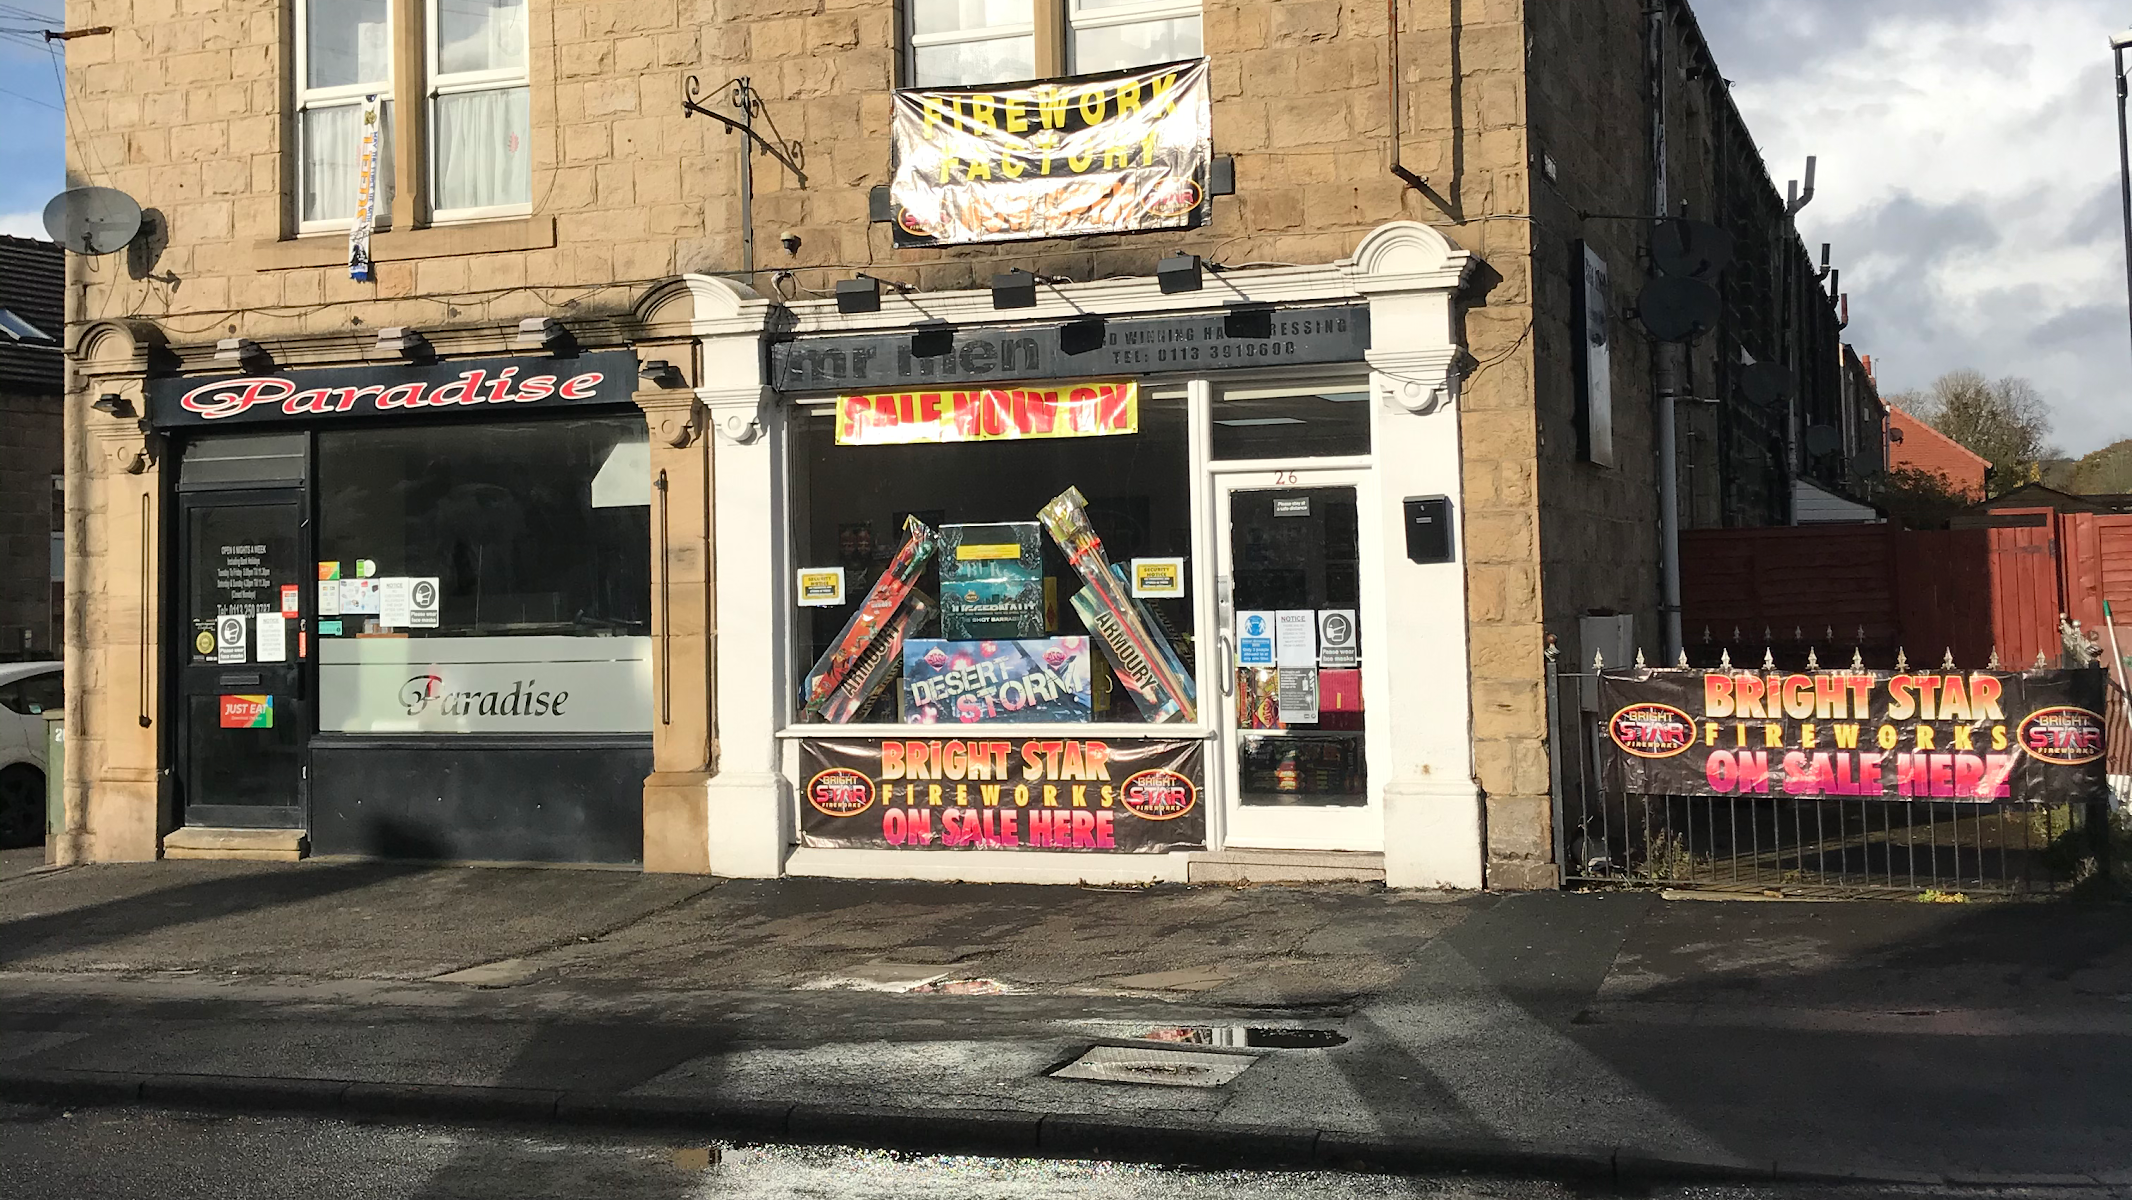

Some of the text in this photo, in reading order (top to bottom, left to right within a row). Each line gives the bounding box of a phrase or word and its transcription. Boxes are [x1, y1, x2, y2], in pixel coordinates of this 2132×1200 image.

[921, 73, 1178, 139] FIREWORK
[939, 131, 1158, 184] FACTORY
[1113, 350, 1148, 365] TEL:
[1158, 345, 1199, 362] 0113
[1125, 327, 1194, 345] WINNING
[790, 337, 1040, 382] mr men
[180, 366, 604, 420] Paradise
[844, 384, 1128, 438] SALE NOW ON
[1274, 470, 1297, 485] 26
[221, 546, 232, 555] OPEN
[841, 617, 901, 699] ARMOURY
[1094, 611, 1161, 693] ARMOURY
[398, 674, 569, 717] Paradise
[911, 655, 1014, 707] DESERT
[956, 663, 1083, 724] STORM
[1888, 674, 2005, 721] STAR
[225, 703, 267, 715] JUST EAT
[1619, 722, 1685, 743] STAR
[1626, 741, 1677, 749] FIREWORKS
[1705, 722, 2008, 750] FIREWORKS
[2030, 727, 2101, 748] STAR
[2037, 747, 2095, 755] FIREWORKS
[1021, 740, 1111, 781] STAR
[1706, 750, 2011, 798] ON SALE HERE
[816, 785, 867, 803] STAR
[882, 783, 1114, 807] FIREWORKS
[1129, 786, 1187, 805] STAR
[882, 808, 1115, 849] ON SALE HERE
